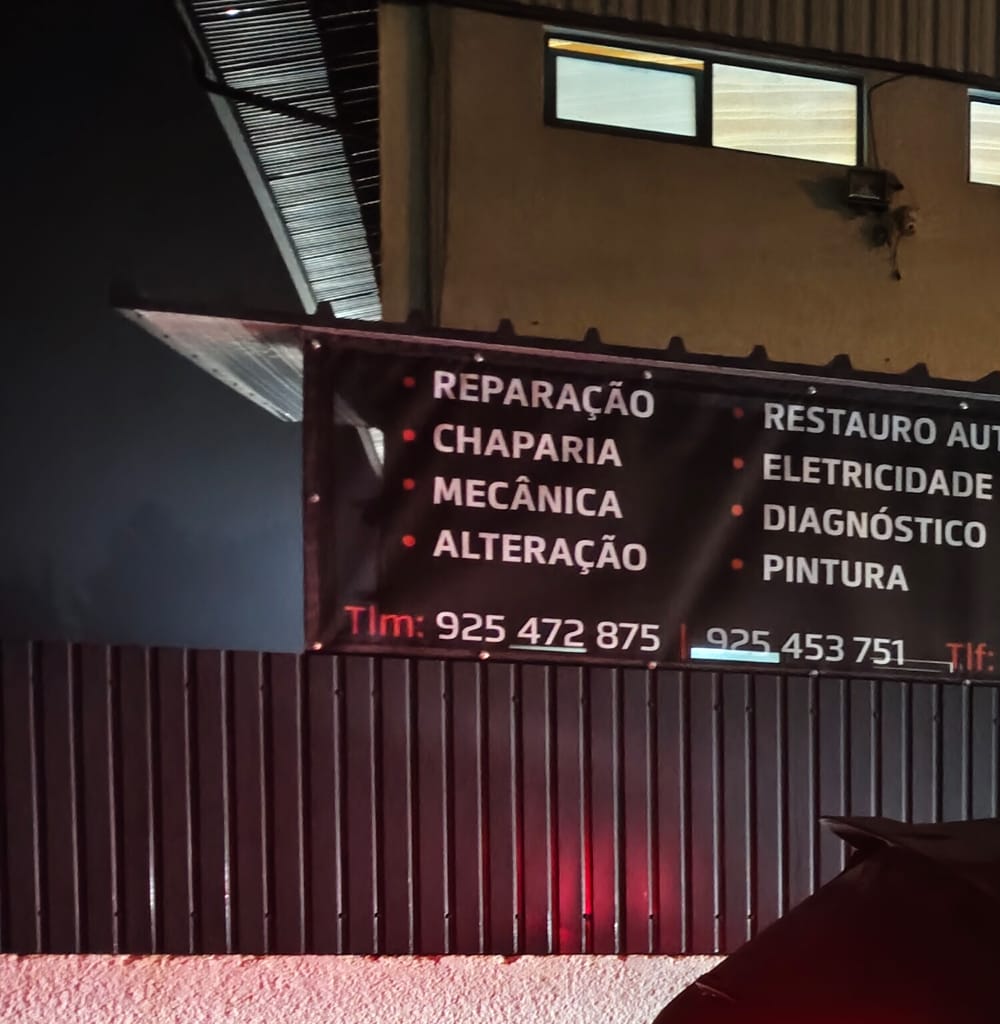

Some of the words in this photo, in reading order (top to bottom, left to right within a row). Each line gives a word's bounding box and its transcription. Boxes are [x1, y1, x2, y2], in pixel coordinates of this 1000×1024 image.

[433, 371, 654, 421] REPARAÇÃO
[433, 423, 622, 467] CHAPARIA
[764, 402, 936, 445] RESTAURO
[433, 476, 623, 519] MECÂNICA
[763, 453, 993, 500] ELETRICIDADE
[763, 503, 987, 549] DIAGNÓSTICO
[433, 529, 648, 575] ALTERAÇÃO
[763, 554, 909, 592] PINTURA
[344, 605, 424, 638] Tlm:
[435, 611, 506, 642] 925
[517, 617, 585, 647] 472
[596, 621, 661, 652] 875
[706, 627, 771, 653] 925
[781, 632, 845, 663] 453
[853, 636, 904, 666] 751
[946, 642, 994, 673] Tlf:
